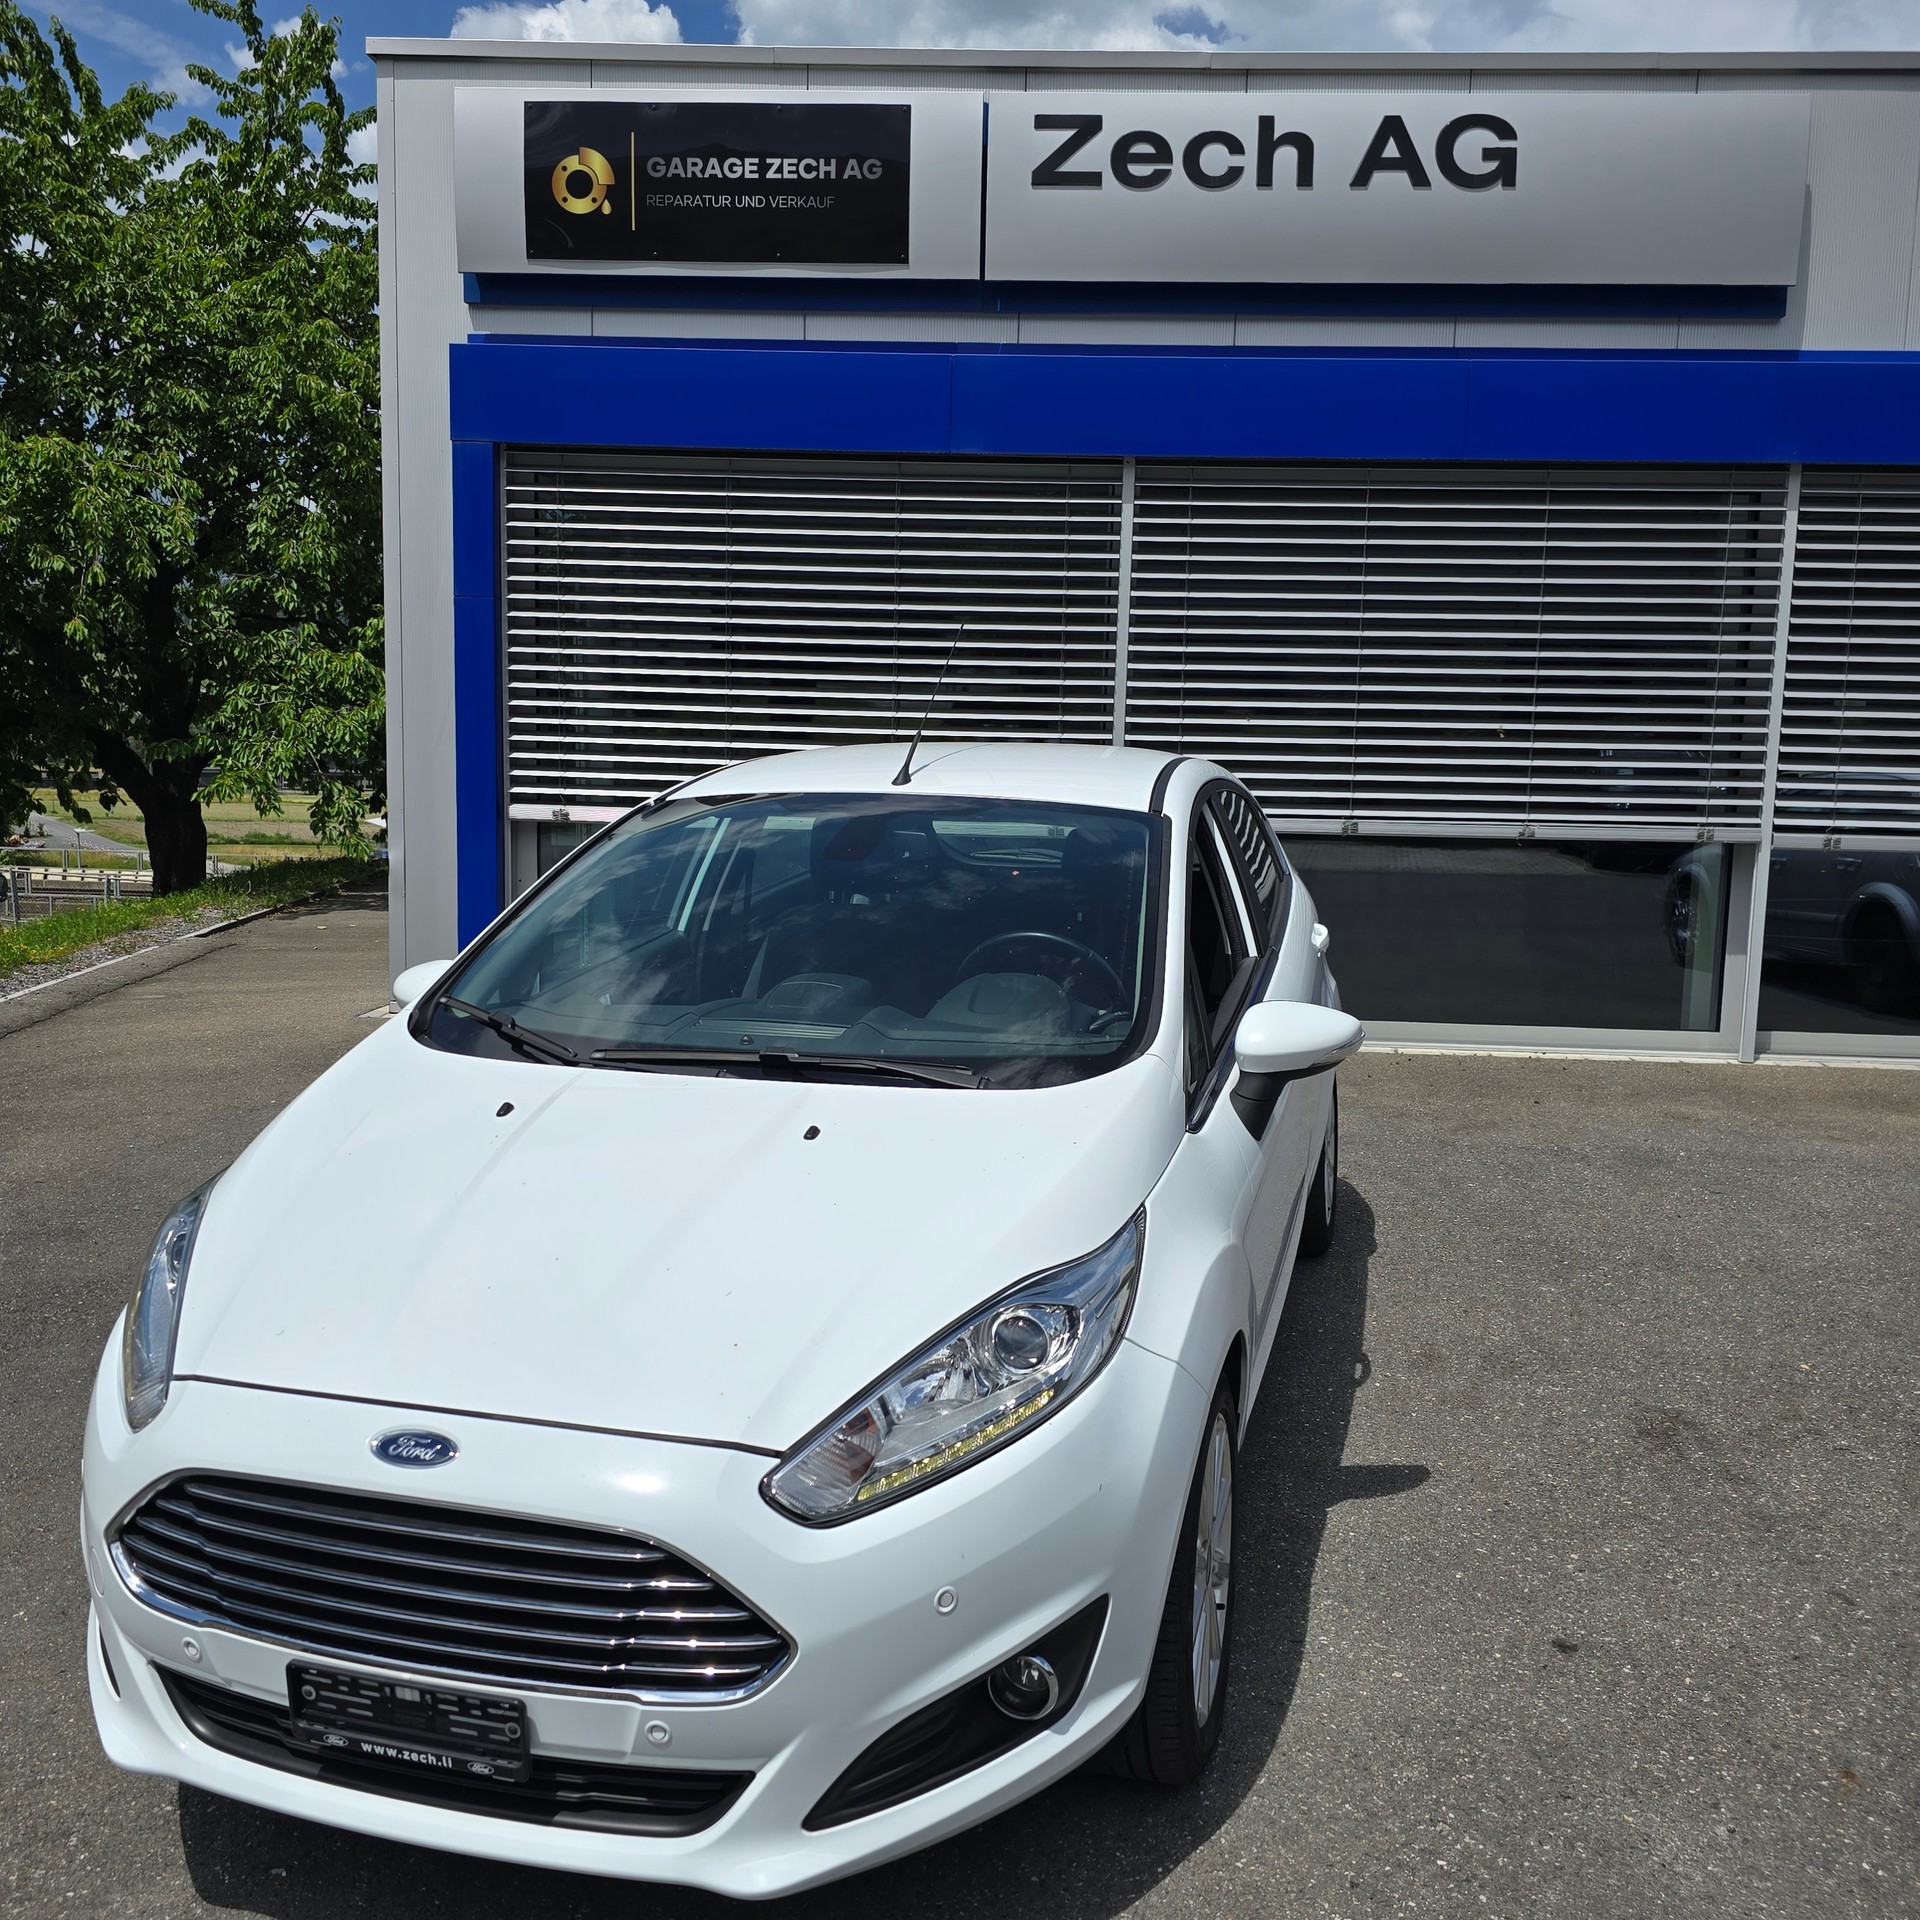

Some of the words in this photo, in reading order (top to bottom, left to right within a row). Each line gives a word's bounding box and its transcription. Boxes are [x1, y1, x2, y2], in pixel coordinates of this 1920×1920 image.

[1031, 114, 1314, 191] Zech
[1349, 113, 1518, 190] AG
[646, 156, 759, 179] GARAGE
[765, 157, 837, 180] ZECH
[843, 158, 883, 180] AG
[646, 194, 732, 208] REPARATUR
[735, 195, 766, 208] UND
[770, 196, 835, 209] VERKAUF
[388, 1436, 441, 1460] Ford
[361, 1742, 452, 1768] www.zech.li
